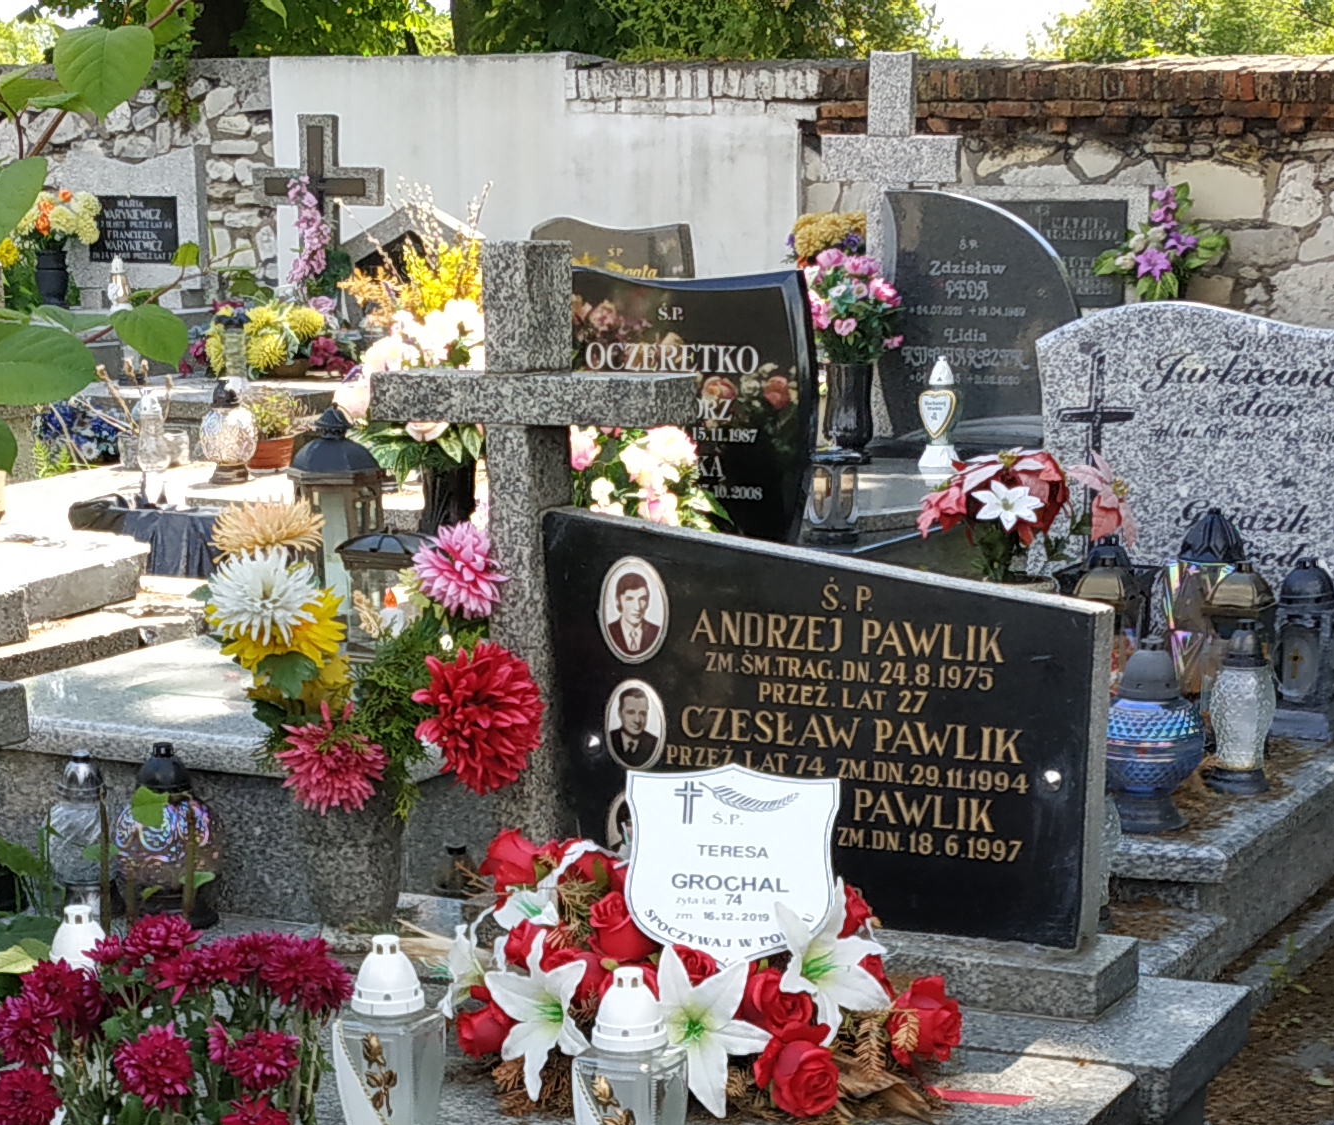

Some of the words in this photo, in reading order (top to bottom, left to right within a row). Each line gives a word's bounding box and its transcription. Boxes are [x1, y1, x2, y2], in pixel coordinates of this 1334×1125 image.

[929, 260, 1006, 276] Zdzisław
[657, 302, 684, 321] Ś.P.
[943, 327, 988, 344] Lidia
[585, 341, 759, 374] OCZERETKO
[689, 608, 843, 652] ANDRZEJ
[860, 618, 1006, 664] PAWLIK
[842, 687, 888, 711] LAT
[896, 689, 929, 714] 27
[680, 705, 862, 750] CZESŁAW
[873, 718, 1023, 764] PAWLIK
[744, 750, 788, 774] LAT
[795, 754, 826, 777] 74
[853, 787, 996, 834] PAWLIK
[696, 843, 770, 860] TERESA
[671, 872, 790, 894] GROCHAL
[724, 893, 743, 906] 74
[643, 908, 732, 948] SPOCZYWAJ
[739, 937, 753, 948] W
[703, 911, 771, 923] 16.12.2019
